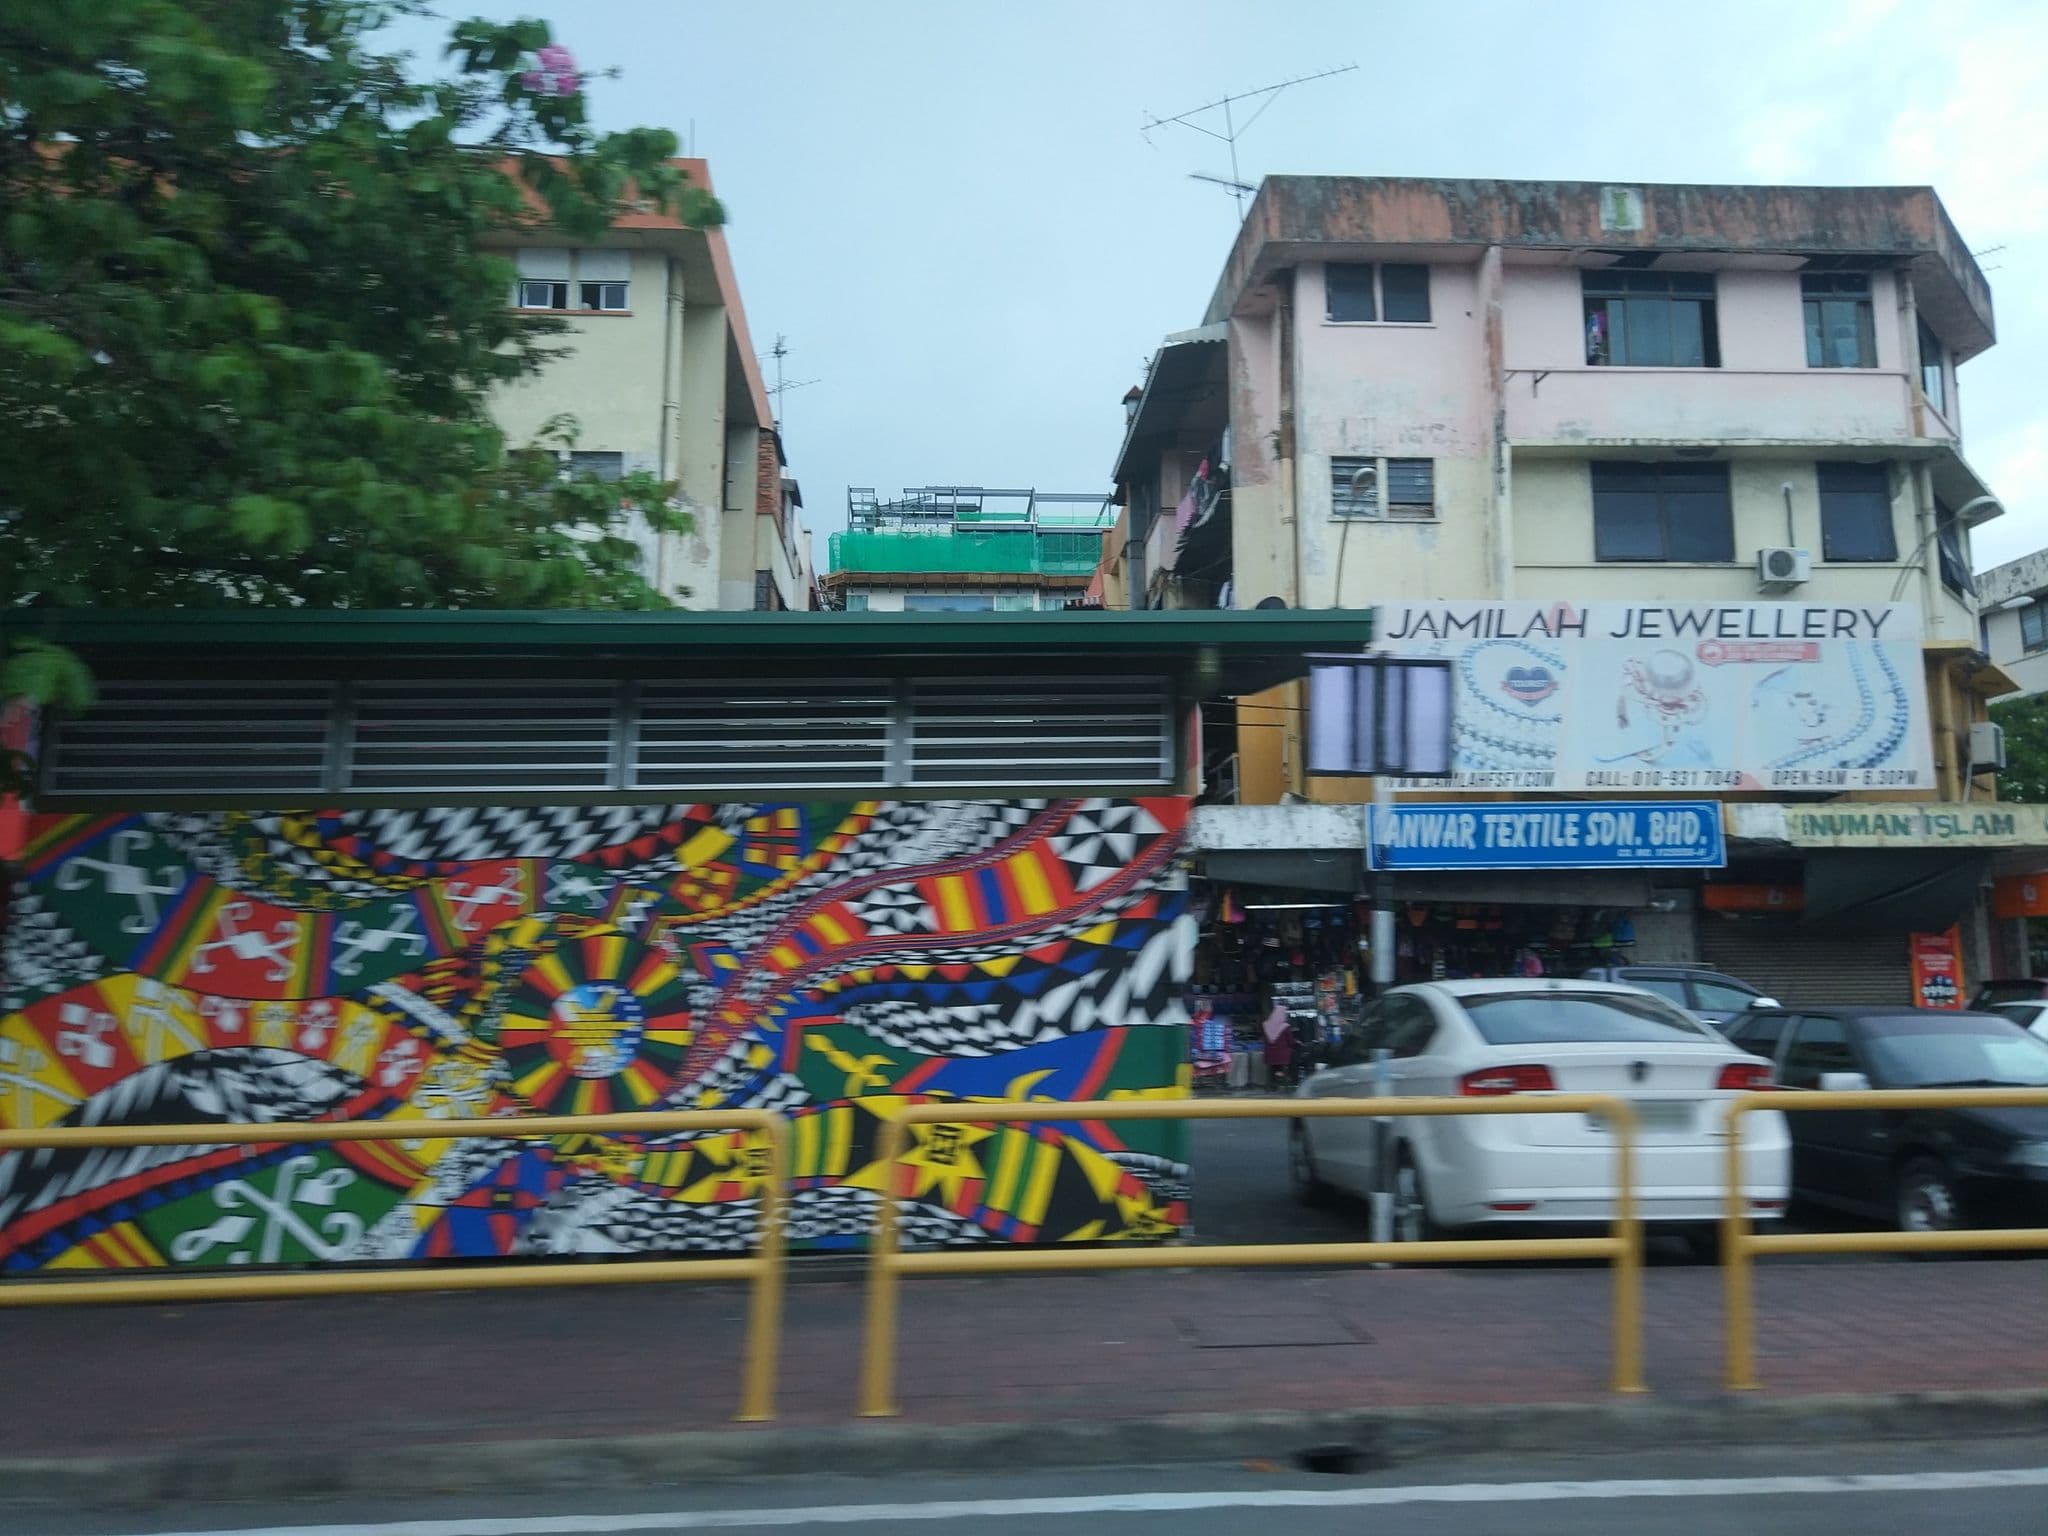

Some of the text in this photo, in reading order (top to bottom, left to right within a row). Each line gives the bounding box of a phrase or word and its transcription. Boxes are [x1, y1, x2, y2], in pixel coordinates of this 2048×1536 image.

[1386, 608, 1893, 639] JAMILAH JEWELLERY
[1380, 810, 1708, 849] ANWAR TEXTILE SDN. BHD.
[1923, 812, 2016, 838] ISLAM
